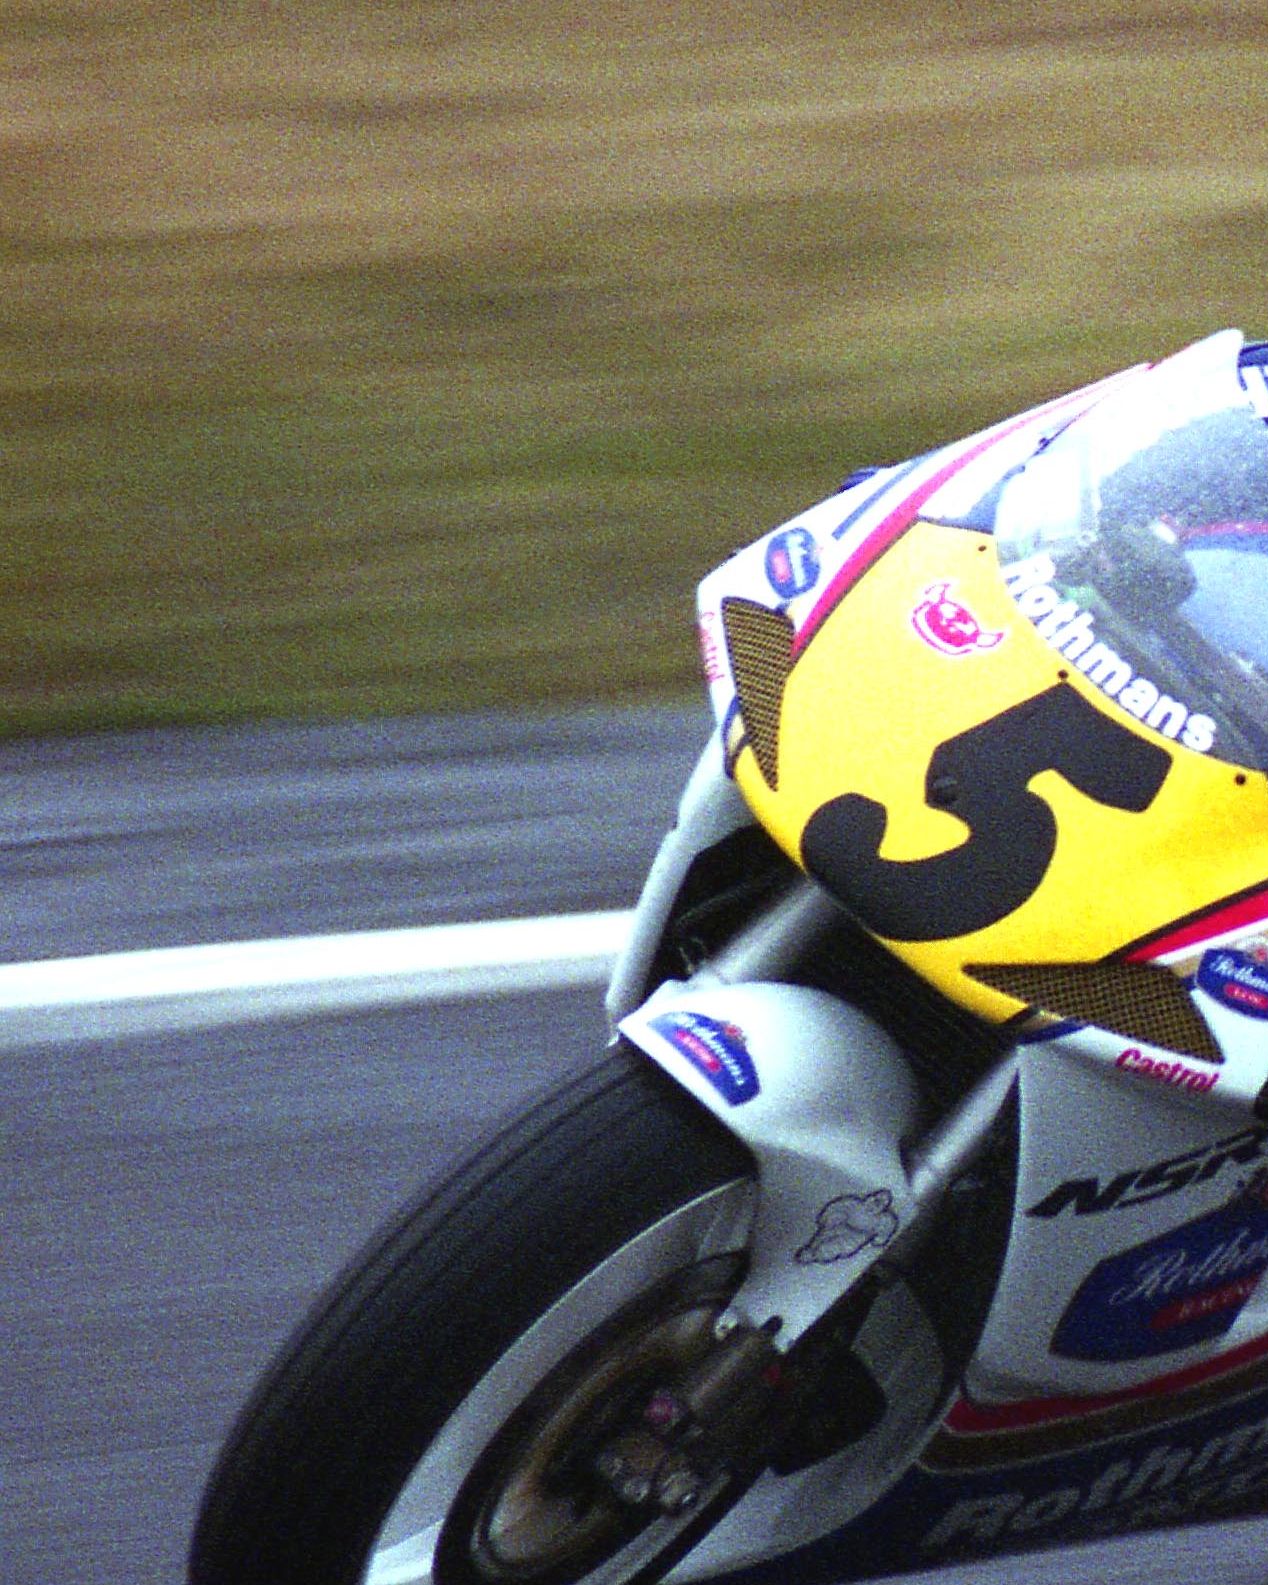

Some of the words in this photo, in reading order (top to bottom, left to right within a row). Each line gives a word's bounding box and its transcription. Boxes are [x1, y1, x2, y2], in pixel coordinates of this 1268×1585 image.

[1001, 553, 1218, 752] Rothmans
[800, 682, 1174, 942] 5
[1115, 1048, 1220, 1094] Castrol
